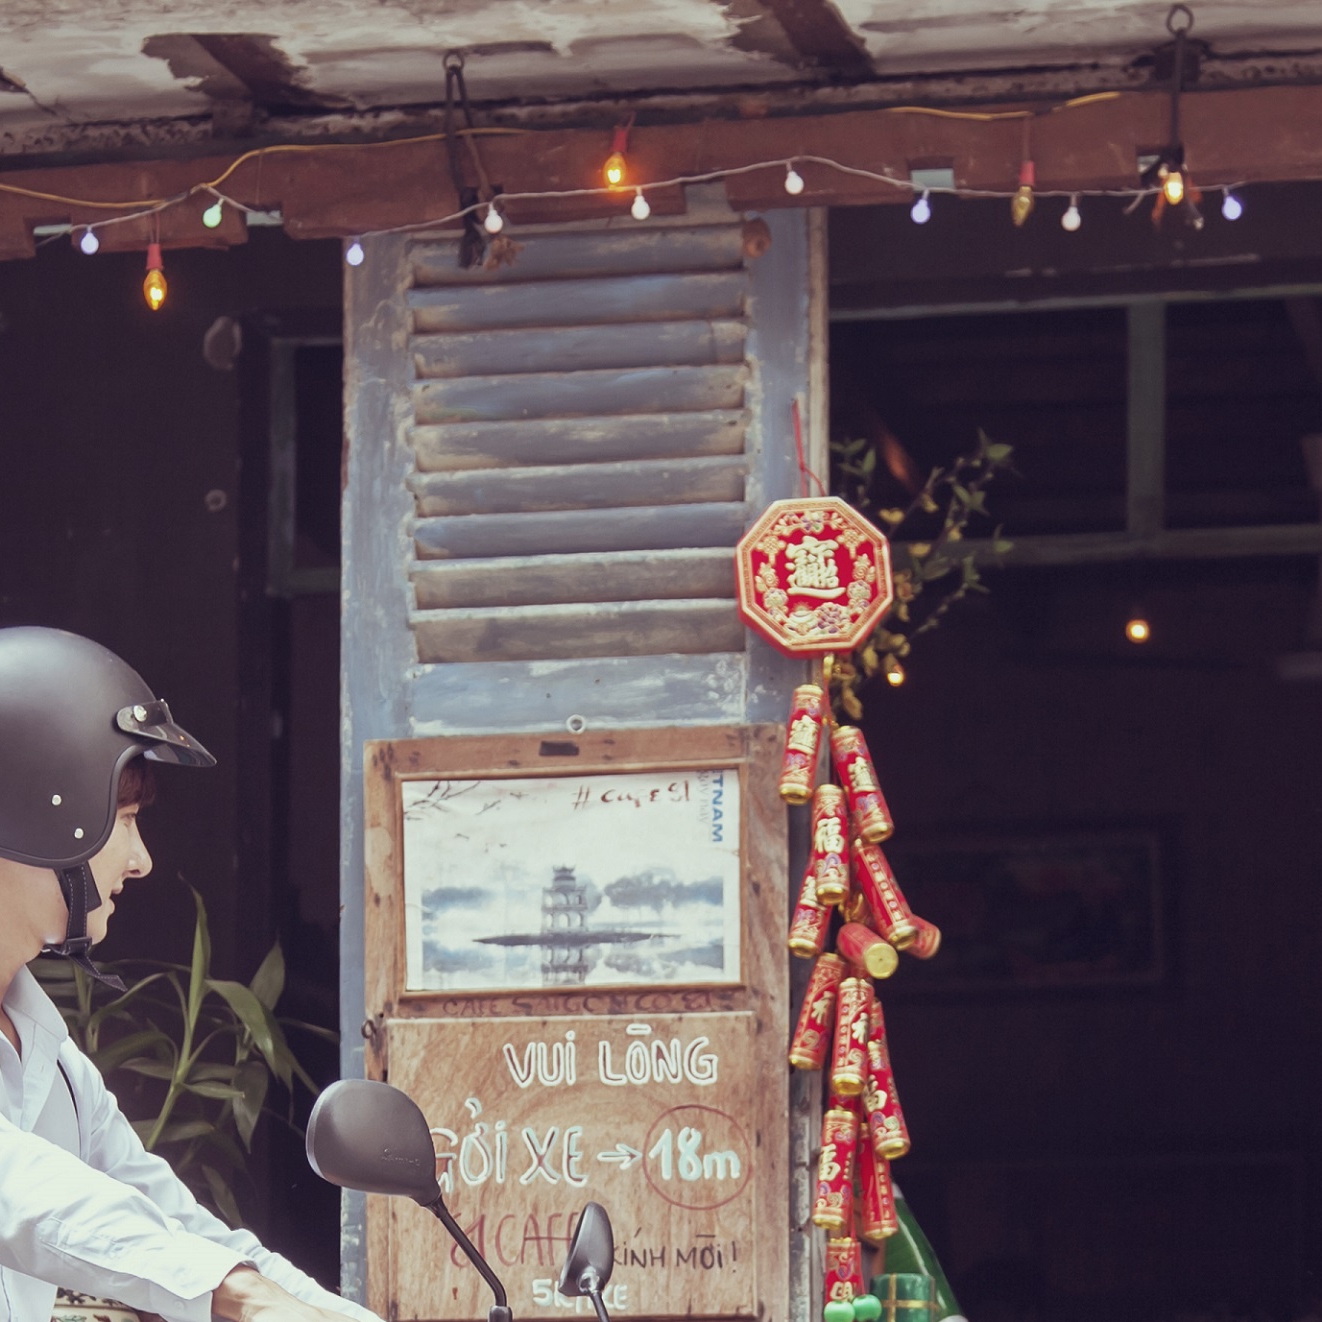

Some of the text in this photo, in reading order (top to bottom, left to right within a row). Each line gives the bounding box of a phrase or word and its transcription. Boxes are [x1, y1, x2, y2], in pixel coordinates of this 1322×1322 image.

[712, 766, 723, 842] TNAM
[519, 1125, 589, 1188] XE
[648, 1126, 742, 1182] 18m
